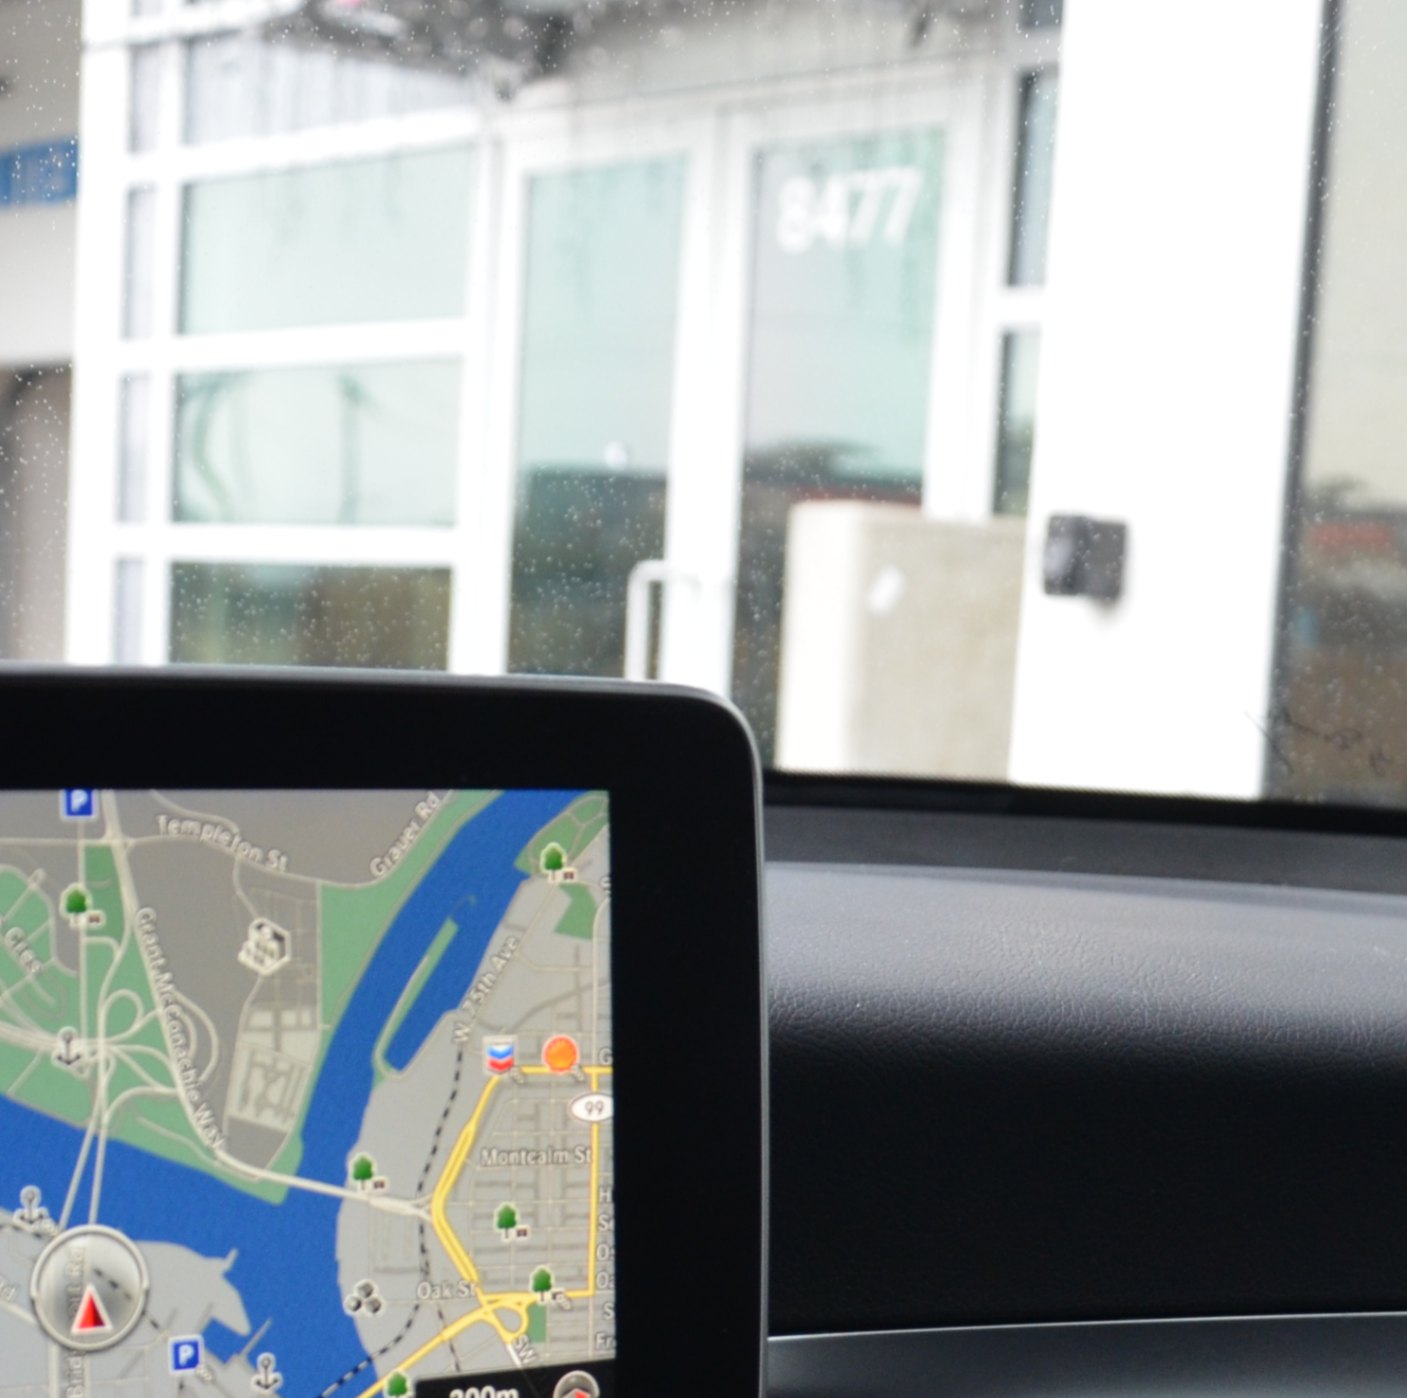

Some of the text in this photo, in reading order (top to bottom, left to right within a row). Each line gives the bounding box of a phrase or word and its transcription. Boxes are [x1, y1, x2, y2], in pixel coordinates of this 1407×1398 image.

[777, 166, 923, 254] 8477
[155, 814, 289, 873] Templeton St
[370, 791, 441, 876] Grauer Rd
[195, 1102, 227, 1151] Way
[585, 1100, 604, 1115] 99
[480, 1145, 592, 1166] Montcalm St
[417, 1281, 476, 1299] Oak St
